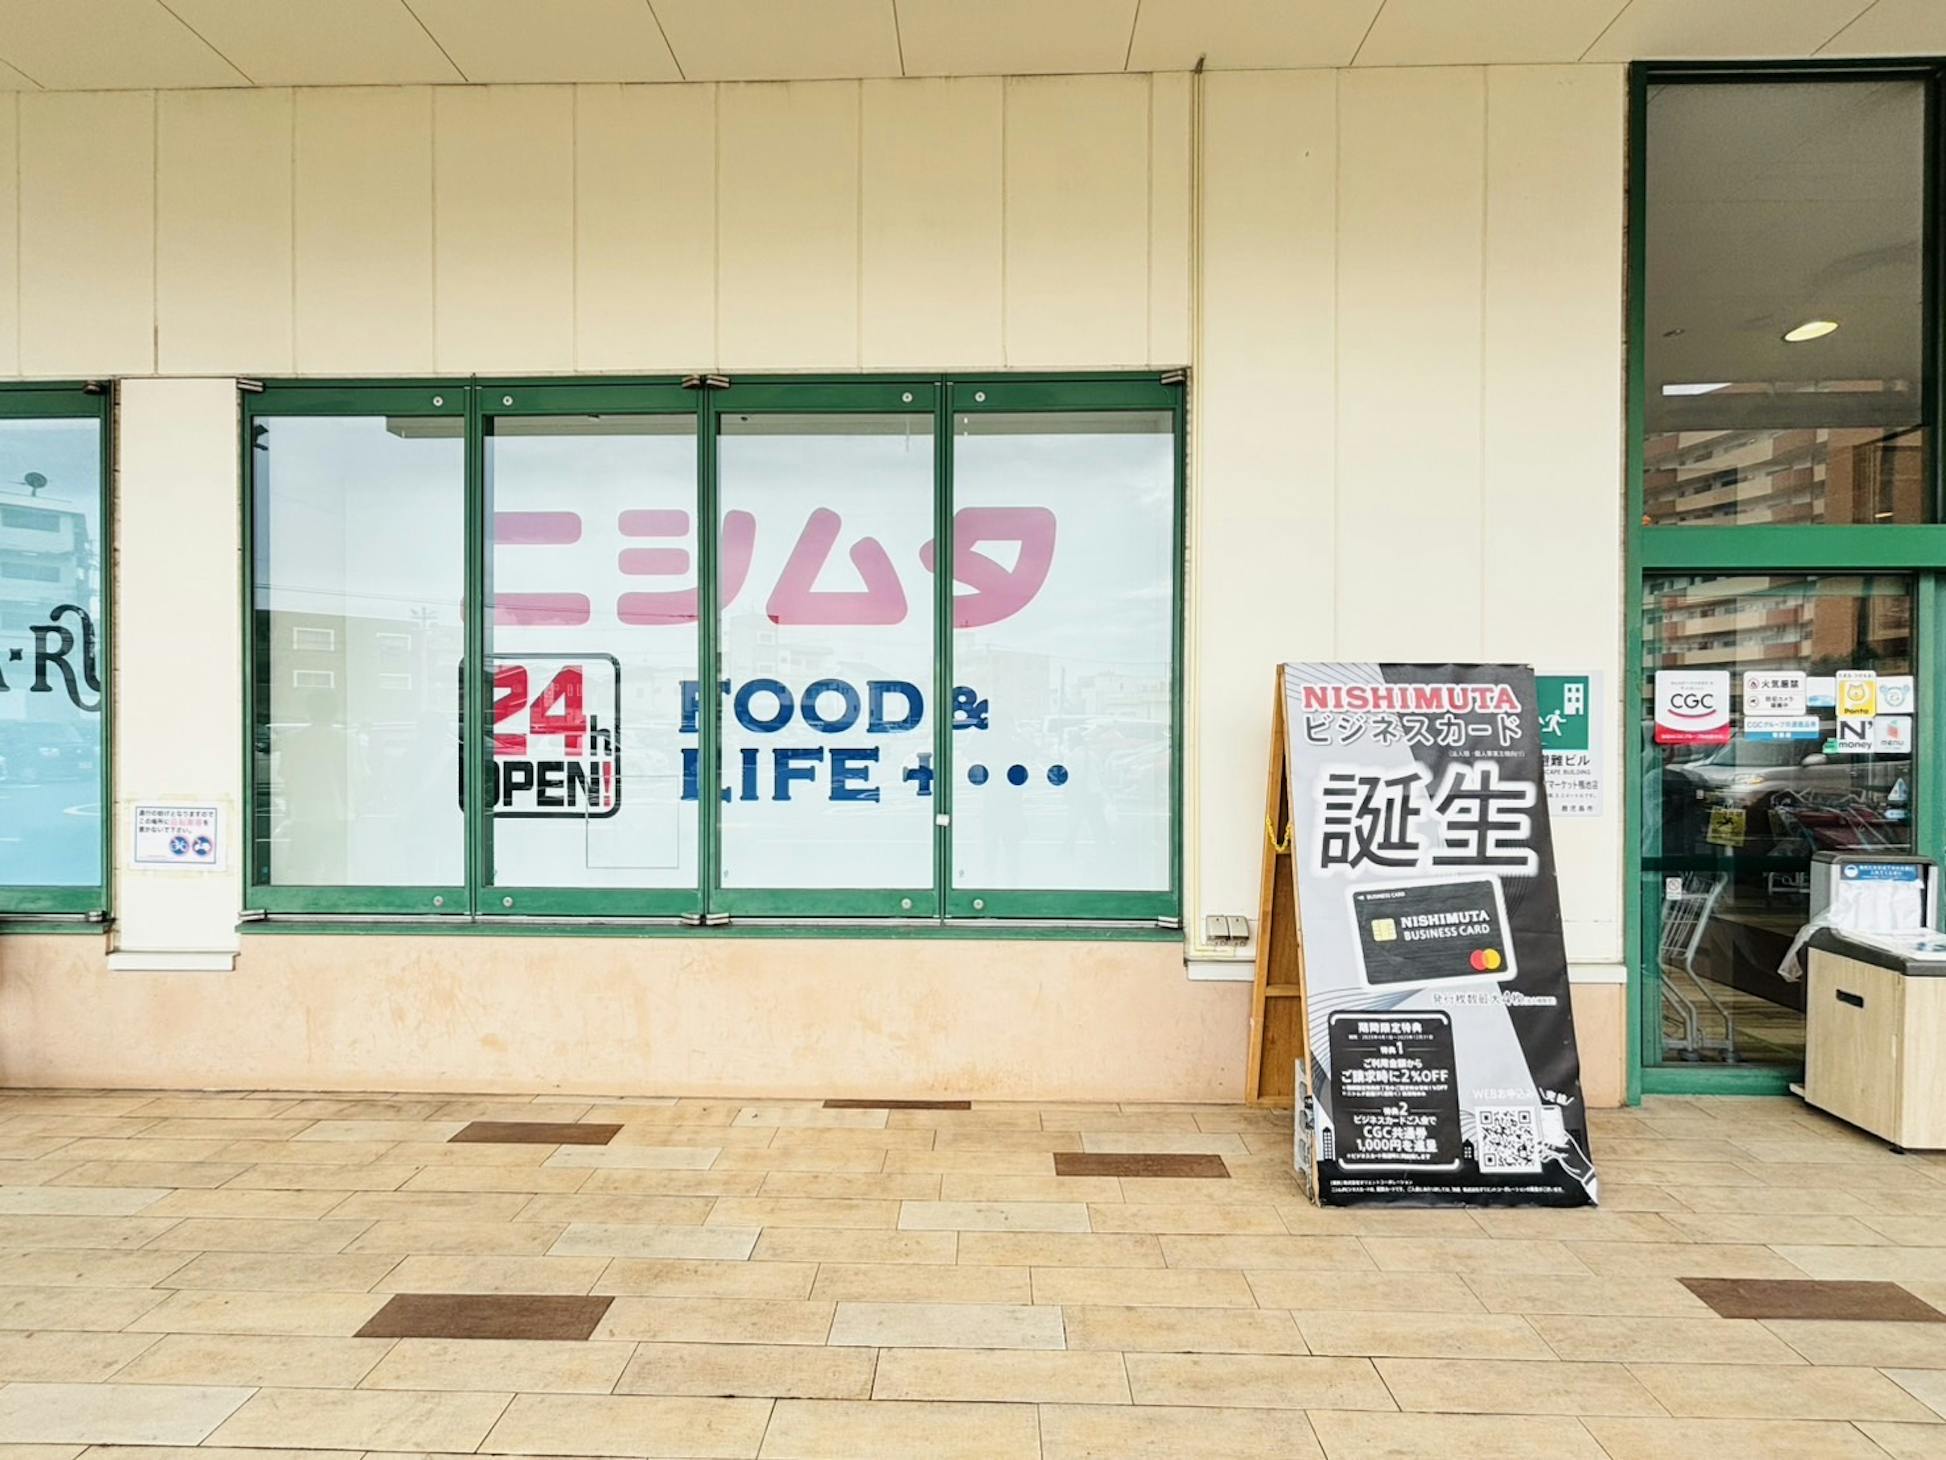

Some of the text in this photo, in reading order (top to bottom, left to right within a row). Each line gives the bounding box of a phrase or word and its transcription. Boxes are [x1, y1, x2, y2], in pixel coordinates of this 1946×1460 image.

[460, 507, 1056, 628] ニシムタ
[1761, 680, 1799, 688] 火気厳禁
[679, 678, 924, 734] FOOD
[1303, 686, 1521, 712] NISHIMUTA
[1671, 693, 1713, 709] CGC
[1304, 714, 1523, 746] ビジネスカード
[1838, 741, 1872, 749] money
[681, 746, 880, 802] LIFE
[1321, 769, 1528, 869] 誕生
[1401, 910, 1490, 929] NISHIMUTA
[1404, 924, 1490, 941] BUSINESS CARD
